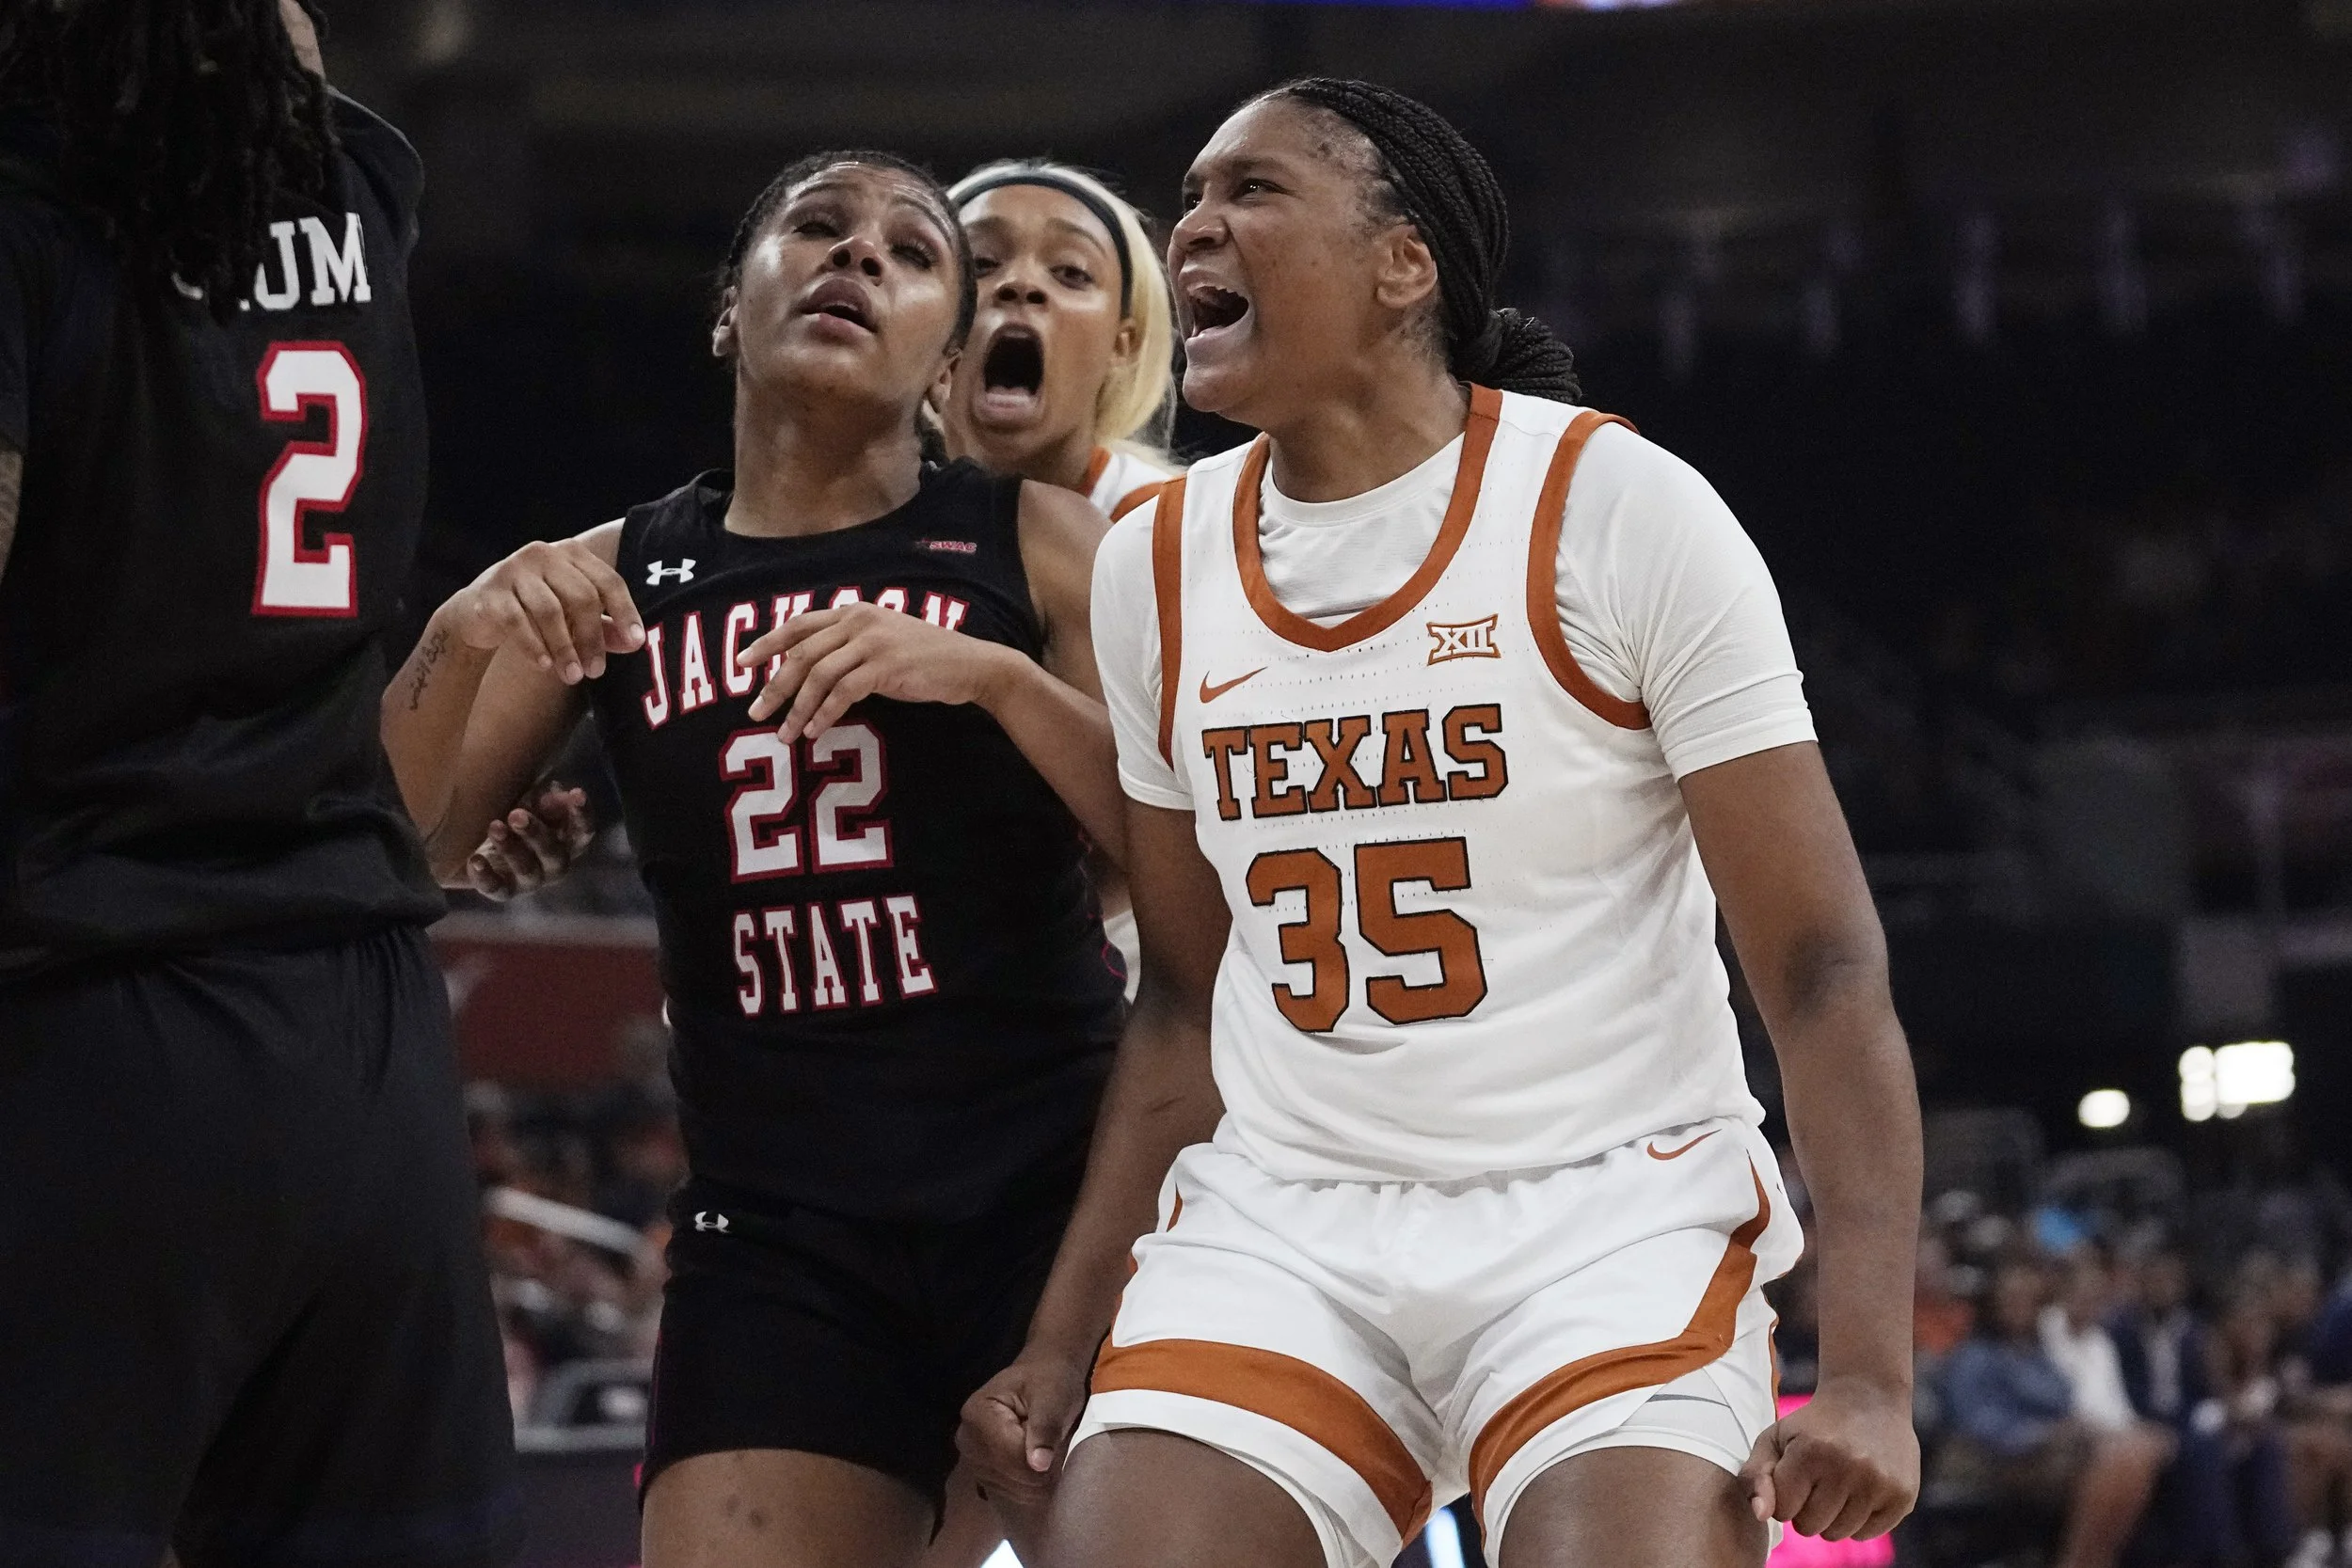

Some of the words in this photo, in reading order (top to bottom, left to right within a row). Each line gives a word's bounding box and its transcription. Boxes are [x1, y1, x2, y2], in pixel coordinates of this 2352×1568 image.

[251, 340, 369, 617] 2
[929, 540, 977, 554] SWAC
[641, 586, 970, 730] JACK
[718, 719, 894, 884] 22
[1201, 703, 1509, 821] TEXAS
[732, 893, 939, 1021] STATE
[1245, 836, 1488, 1033] 35
